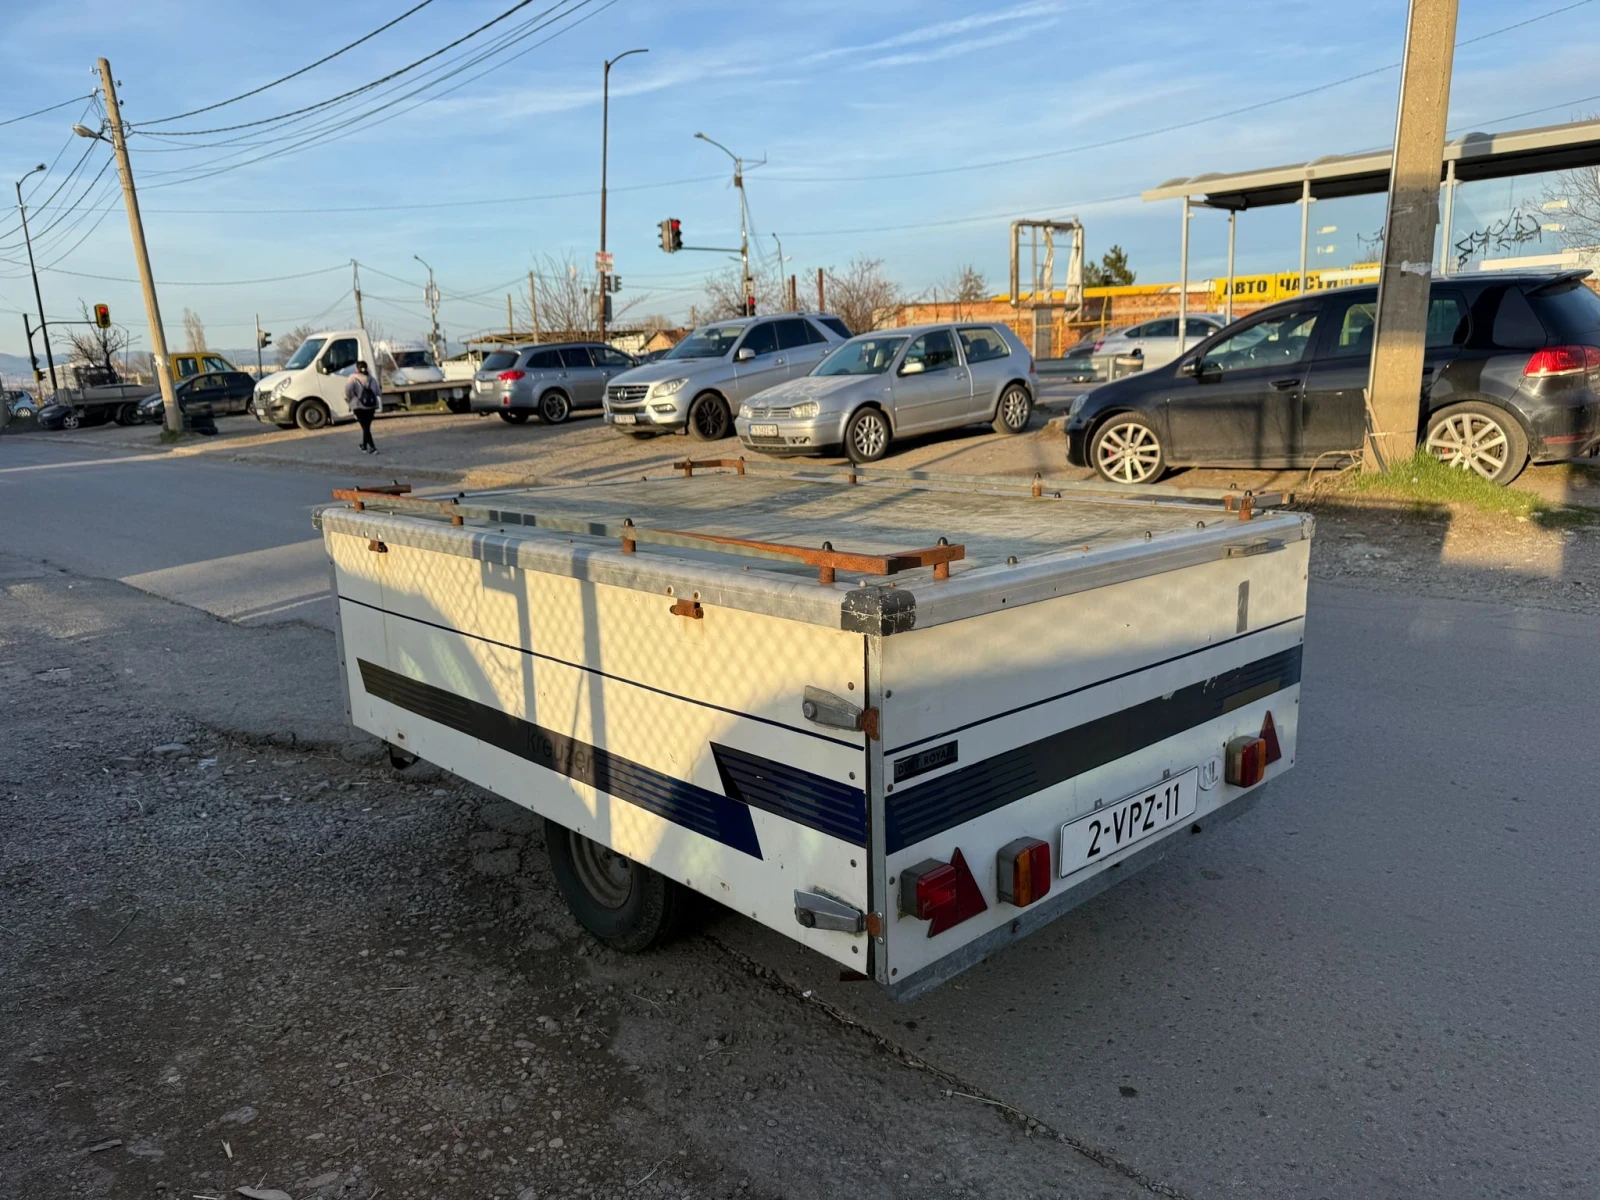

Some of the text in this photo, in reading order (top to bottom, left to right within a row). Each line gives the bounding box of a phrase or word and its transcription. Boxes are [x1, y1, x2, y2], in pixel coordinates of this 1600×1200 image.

[1224, 280, 1268, 296] АВТО
[897, 758, 921, 775] DUT
[1202, 760, 1219, 788] NL
[1087, 783, 1179, 858] 2-VPZ-11
